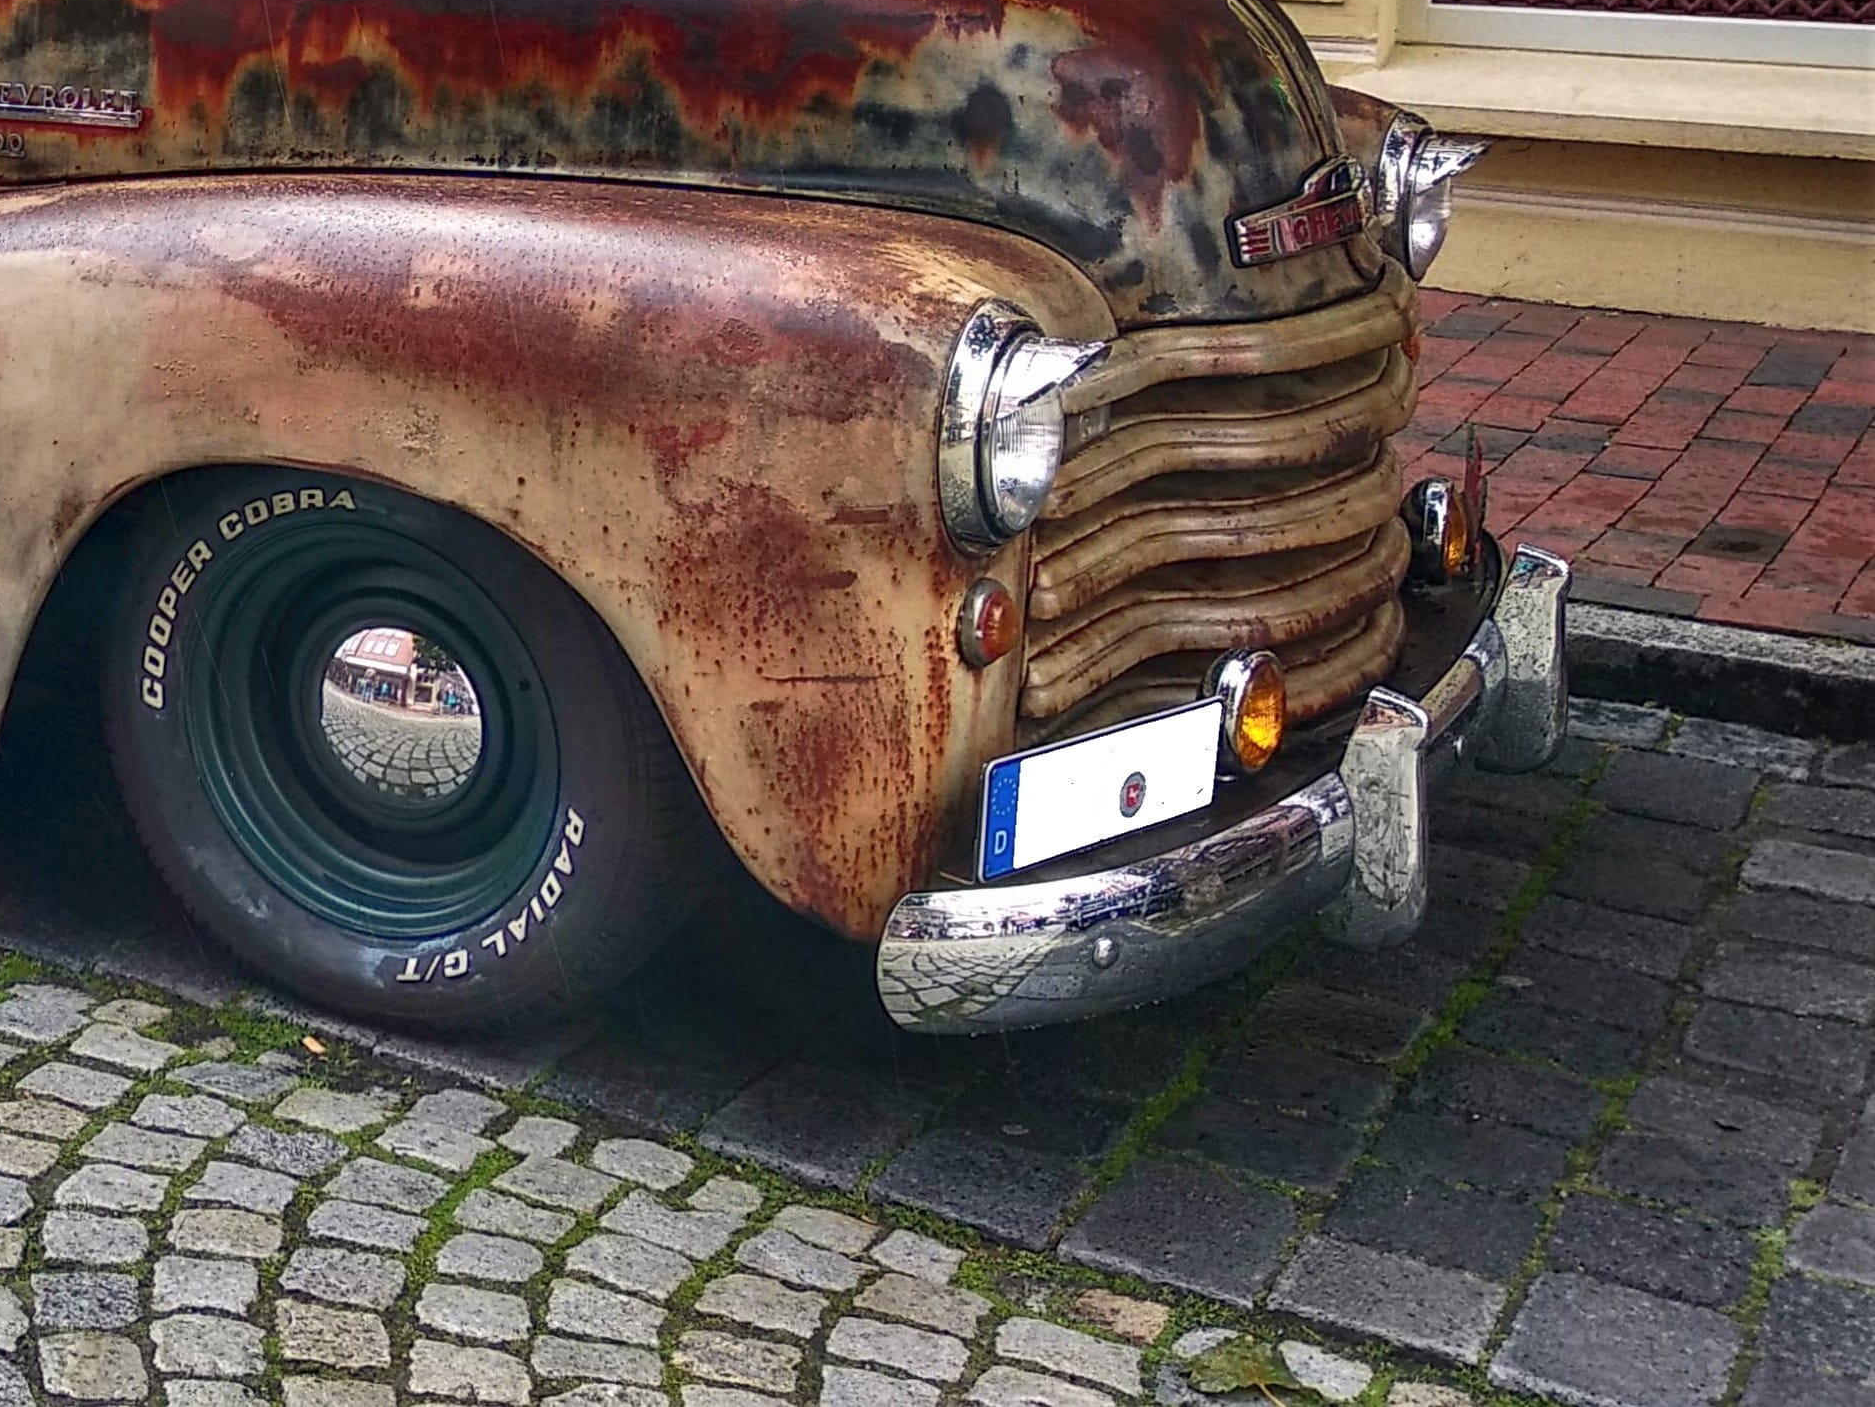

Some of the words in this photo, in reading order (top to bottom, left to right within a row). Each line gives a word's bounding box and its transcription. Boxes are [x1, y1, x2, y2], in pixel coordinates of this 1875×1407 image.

[142, 539, 214, 709] COOPER
[218, 488, 356, 542] COBRA
[481, 807, 586, 958] RADIAL
[993, 829, 1008, 856] D
[395, 949, 468, 982] G/T
